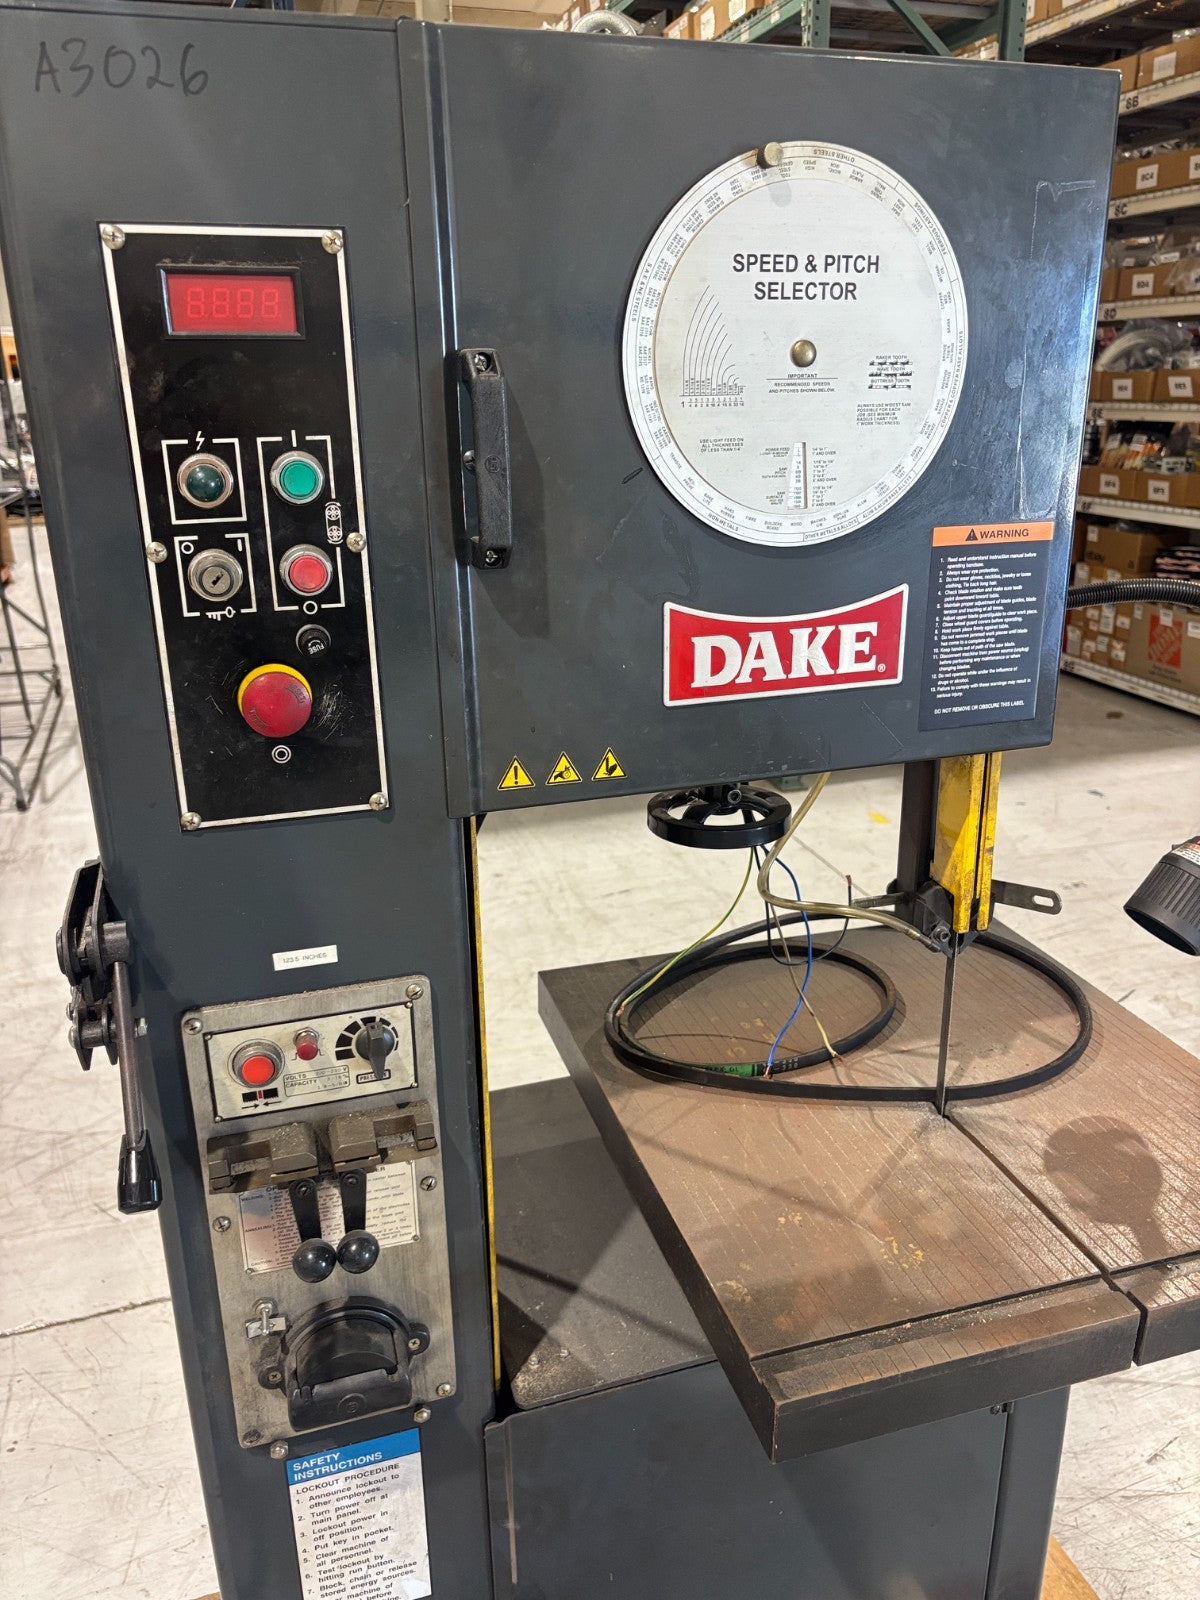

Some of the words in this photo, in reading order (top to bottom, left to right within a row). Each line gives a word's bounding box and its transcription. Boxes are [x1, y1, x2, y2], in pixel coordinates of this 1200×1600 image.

[35, 37, 209, 98] A3026
[813, 149, 836, 157] STEELS
[836, 153, 855, 163] OTHER
[914, 202, 933, 229] CASTINGS
[932, 228, 947, 255] FERROUS
[732, 253, 798, 273] SPEED
[804, 254, 817, 273] &
[824, 254, 879, 273] PITCH
[754, 281, 857, 300] SELECTOR
[940, 405, 951, 428] COPPER
[951, 373, 960, 398] COPPER
[708, 513, 719, 522] NON
[719, 519, 739, 531] METALS
[805, 531, 819, 539] OTHER
[820, 527, 837, 536] METALS
[840, 519, 857, 529] ALLOYS
[979, 528, 1029, 539] WARNING
[308, 644, 325, 655] FUSE
[691, 621, 878, 688] DAKE
[979, 702, 1000, 710] OBSCURE
[302, 953, 327, 961] INCHES
[285, 1079, 317, 1088] CAPACITY
[293, 1452, 340, 1471] SAFETY
[294, 1452, 382, 1481] INSTRUCTIONS
[296, 1479, 340, 1495] LOCKOUT
[345, 1463, 400, 1482] PROCEDURE
[309, 1487, 352, 1502] Announce
[356, 1476, 387, 1489] lockout
[309, 1499, 331, 1509] other
[336, 1486, 384, 1502] employees.
[310, 1509, 330, 1518] Turn
[335, 1501, 360, 1513] power
[365, 1496, 376, 1504] off
[311, 1517, 332, 1526] main
[336, 1508, 361, 1520] panel.
[312, 1521, 346, 1535] Lockout
[351, 1514, 376, 1526] power
[313, 1534, 325, 1542] off
[329, 1525, 364, 1539] position.
[314, 1543, 329, 1551] Put
[364, 1526, 394, 1539] pocket.
[316, 1551, 337, 1560] Clear
[341, 1540, 376, 1553] machine
[331, 1547, 373, 1564] personnel.
[317, 1566, 338, 1576] Test
[338, 1557, 370, 1570] lockout
[318, 1572, 345, 1583] hitting
[349, 1567, 363, 1575] run
[367, 1559, 395, 1571] button.
[349, 1574, 372, 1583] chain
[389, 1561, 417, 1572] release
[320, 1587, 346, 1598] stored
[351, 1579, 378, 1590] energy
[382, 1569, 416, 1581] sources.
[346, 1587, 381, 1600] machine
[366, 1591, 392, 1600] before
